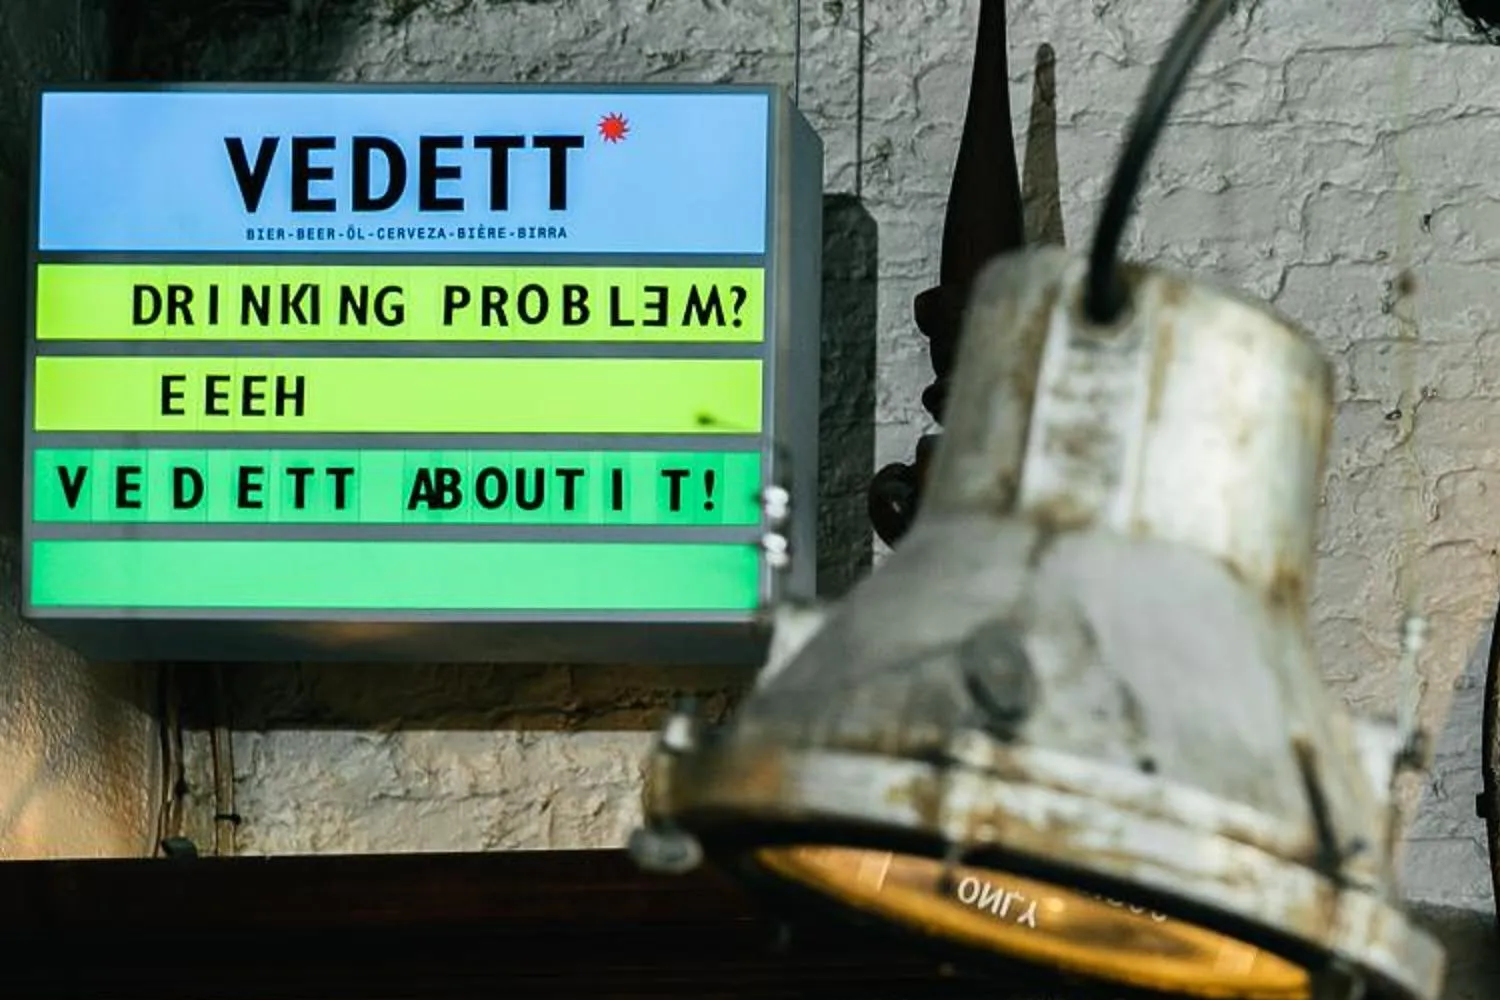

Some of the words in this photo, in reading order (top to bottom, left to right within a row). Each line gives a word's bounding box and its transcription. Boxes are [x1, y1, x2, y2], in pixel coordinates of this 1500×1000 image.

[224, 136, 584, 213] VEDETT
[132, 284, 405, 326] DRINKING
[161, 373, 305, 417] EEEH
[58, 466, 355, 510] VEDETT
